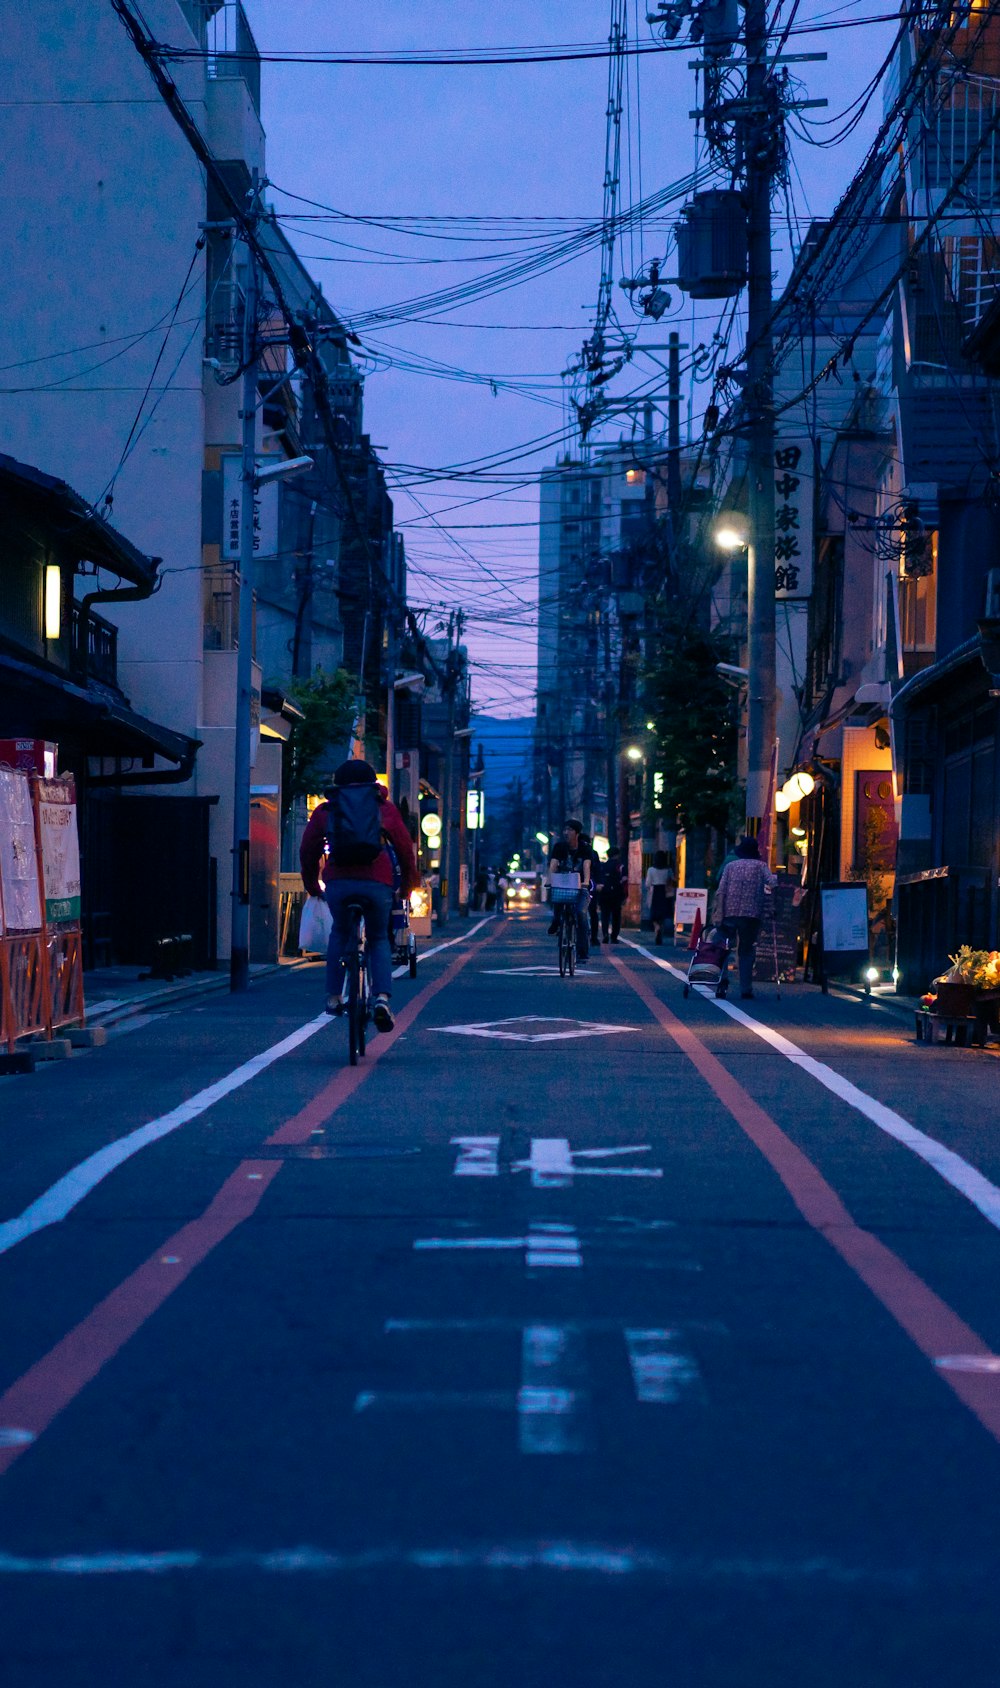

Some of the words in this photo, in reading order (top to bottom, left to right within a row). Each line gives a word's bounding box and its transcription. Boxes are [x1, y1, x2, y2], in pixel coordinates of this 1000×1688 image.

[774, 445, 802, 591] 田中家旅館
